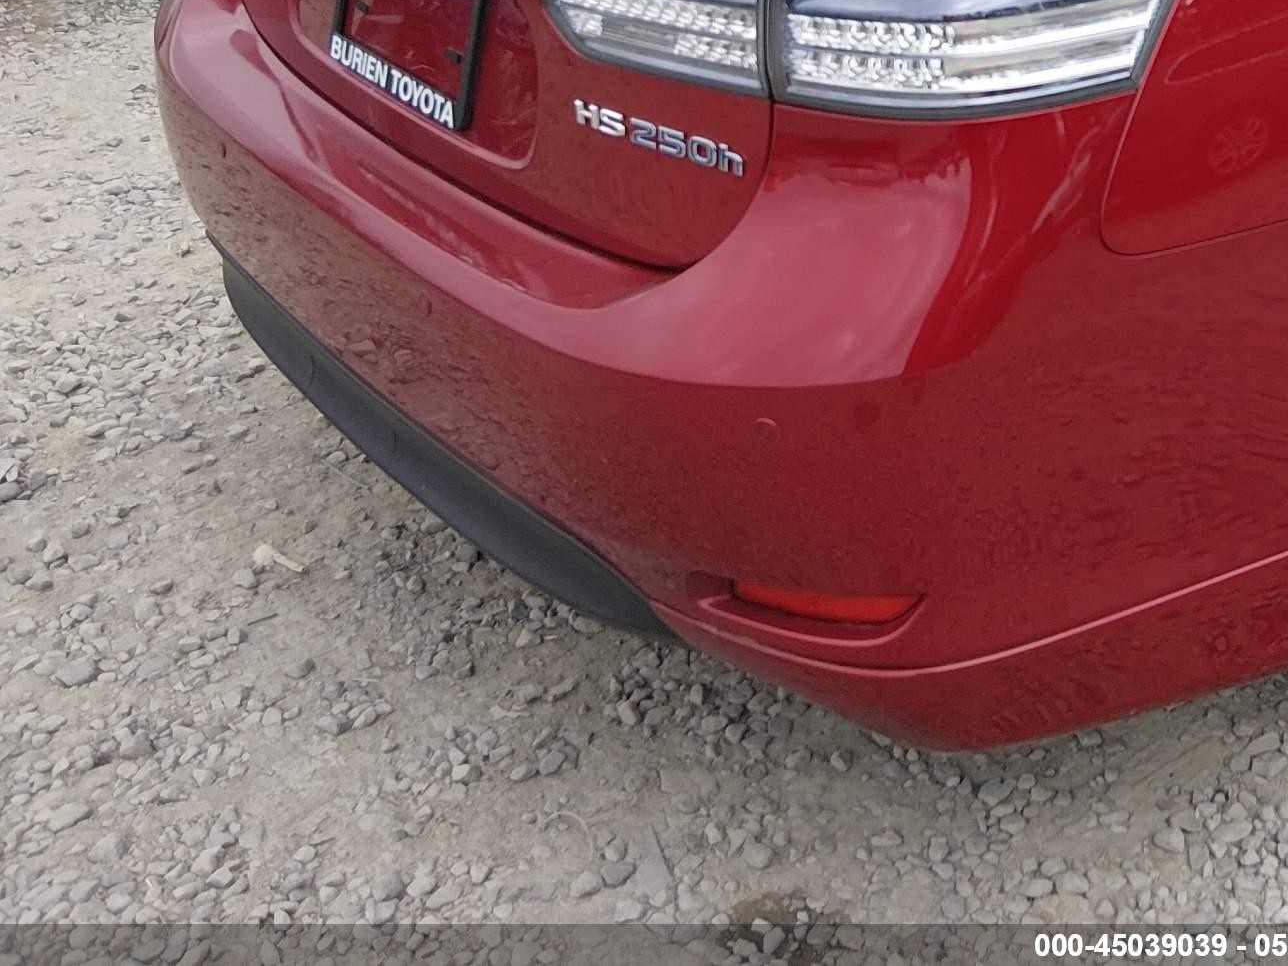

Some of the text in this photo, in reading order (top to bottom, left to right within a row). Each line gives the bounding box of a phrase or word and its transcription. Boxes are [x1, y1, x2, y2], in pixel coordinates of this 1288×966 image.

[329, 35, 454, 129] BURIEN TOYOTA
[573, 98, 744, 178] HS 250h
